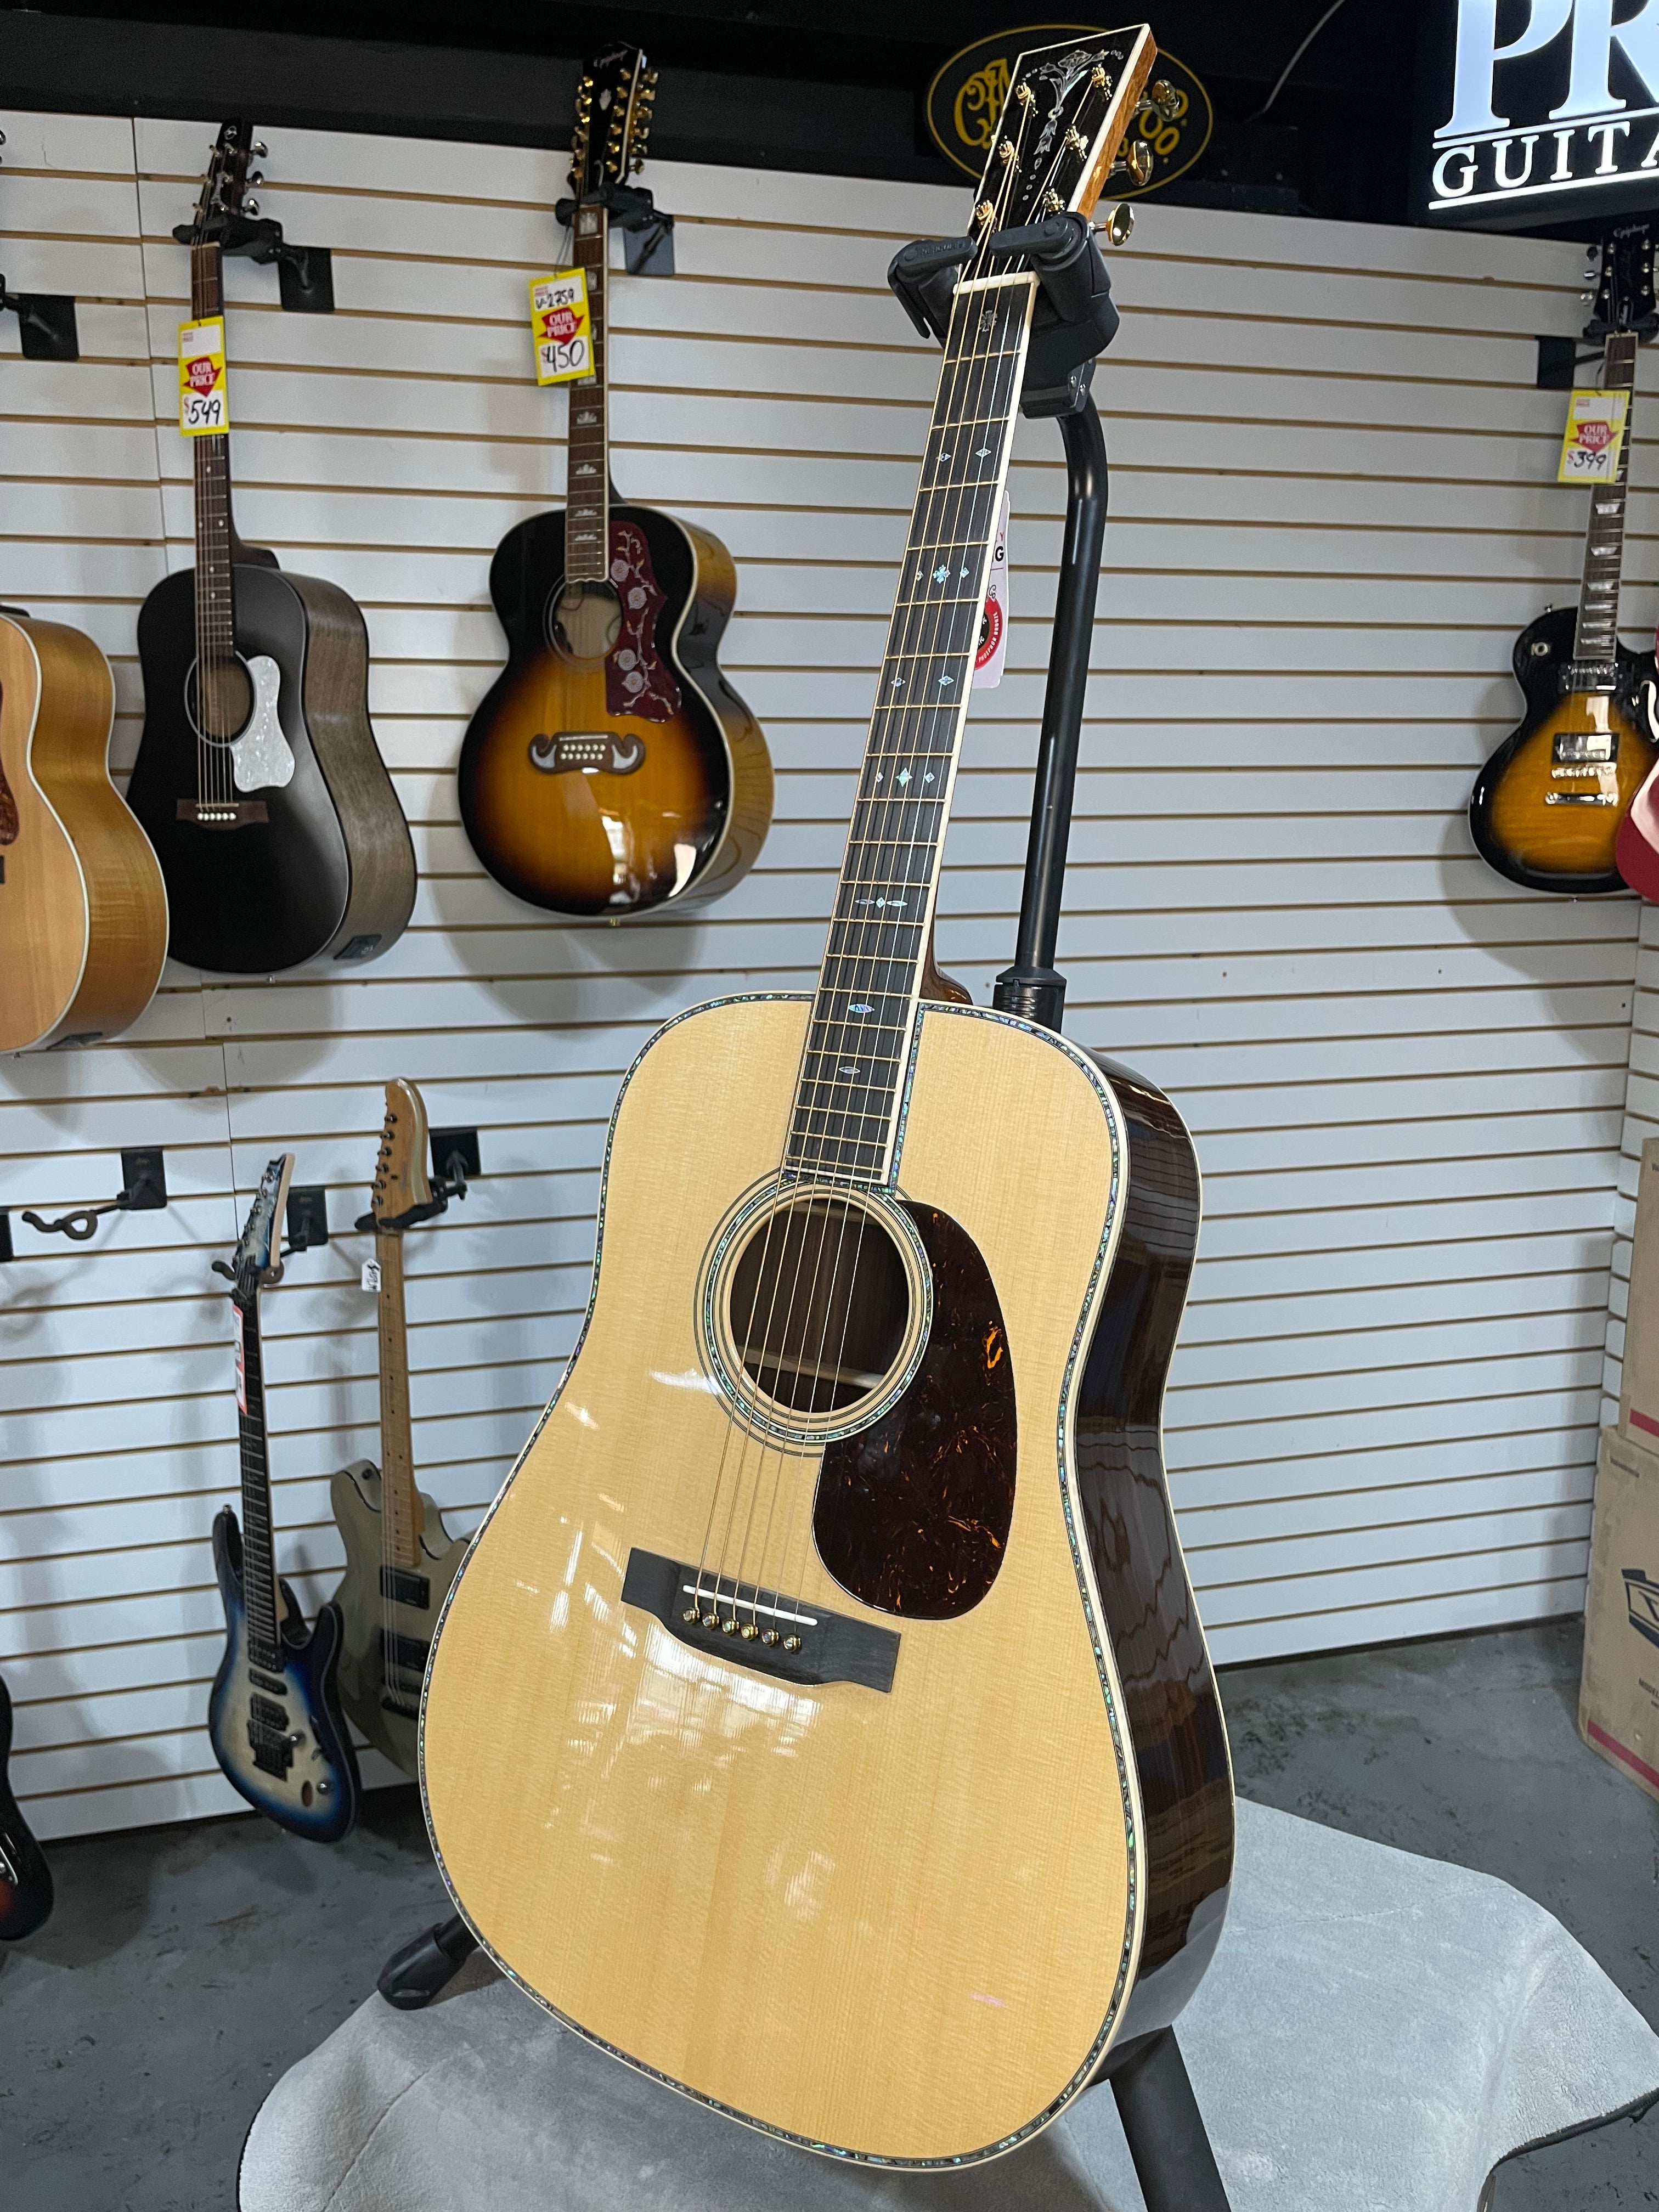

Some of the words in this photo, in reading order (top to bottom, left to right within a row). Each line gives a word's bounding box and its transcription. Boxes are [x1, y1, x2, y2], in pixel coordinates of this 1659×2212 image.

[549, 311, 574, 326] OUR
[192, 362, 212, 376] OUR
[1584, 424, 1608, 436] OUR
[978, 636, 997, 663] PHOSPHOR
